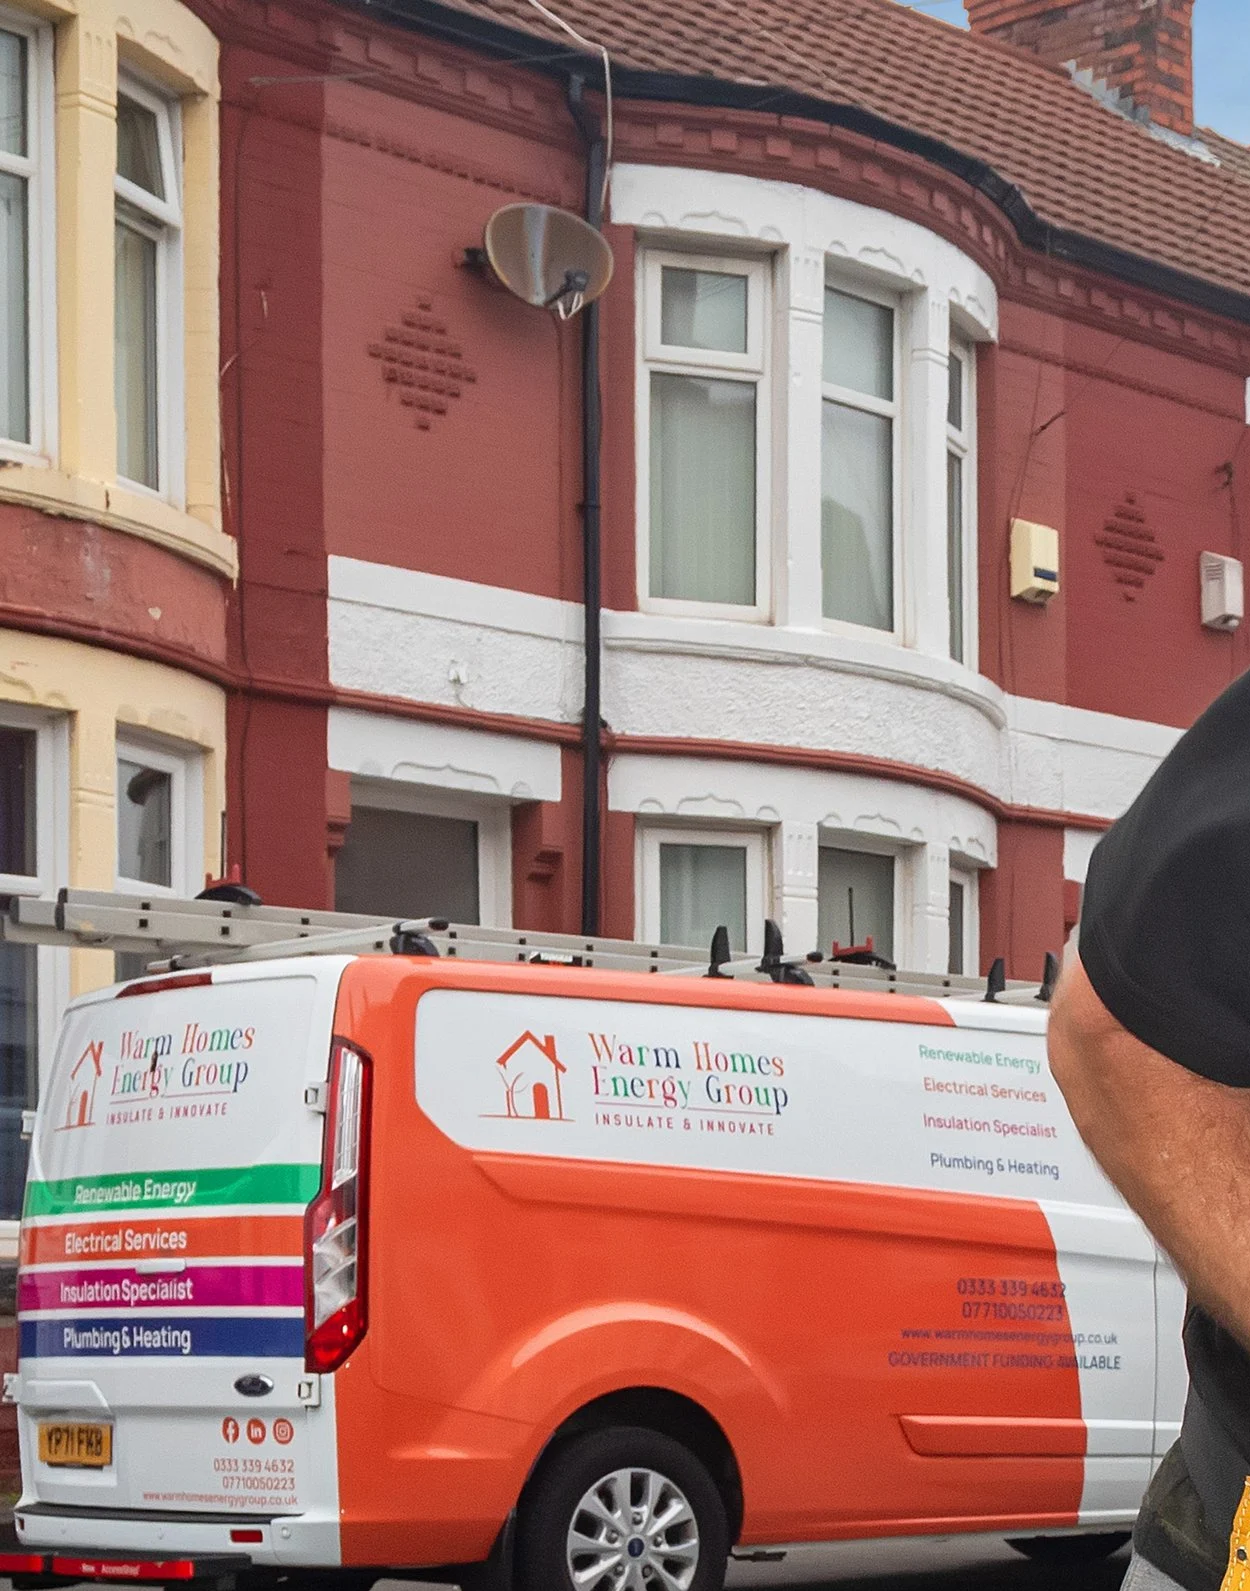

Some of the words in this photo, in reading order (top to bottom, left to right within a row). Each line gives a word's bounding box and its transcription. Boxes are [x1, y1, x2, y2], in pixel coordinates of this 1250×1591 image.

[120, 1030, 172, 1060] Warm
[181, 1022, 255, 1054] Homes
[588, 1032, 681, 1069] Warm
[693, 1040, 785, 1077] Homes
[918, 1044, 992, 1066] Renewable
[995, 1053, 1041, 1074] Energy
[111, 1064, 173, 1098] Energy
[182, 1057, 248, 1093] Group
[591, 1065, 691, 1109] Energy
[705, 1074, 789, 1116] Group
[923, 1076, 988, 1097] Electrical
[991, 1084, 1047, 1102] Services
[106, 1108, 152, 1125] INSULATE
[158, 1109, 164, 1119] &
[170, 1102, 228, 1118] INNOVATE
[595, 1112, 674, 1129] INSULATE
[683, 1119, 692, 1130] &
[700, 1119, 774, 1136] INNOVATE
[923, 1113, 991, 1132] Insulation
[994, 1119, 1058, 1139] Specialist
[930, 1152, 994, 1175] Plumbing
[996, 1158, 1005, 1172] &
[1008, 1160, 1060, 1180] Heating
[74, 1180, 141, 1204] Renewable
[144, 1179, 196, 1203] Energy
[65, 1229, 122, 1254] Electrical
[125, 1228, 187, 1250] Services
[60, 1280, 119, 1303] Insulation
[122, 1278, 193, 1307] Specialist
[957, 1278, 996, 1295] 0333
[1000, 1280, 1027, 1297] 339
[64, 1327, 120, 1354] Plumbing
[122, 1326, 130, 1348] &
[133, 1326, 191, 1354] Heating
[888, 1351, 989, 1368] GOVERNMENT
[993, 1352, 1052, 1369] FUNDING
[1056, 1354, 1121, 1370] AVAILABLE
[213, 1458, 238, 1473] 0333
[241, 1459, 261, 1473] 339
[264, 1459, 294, 1473] 4632
